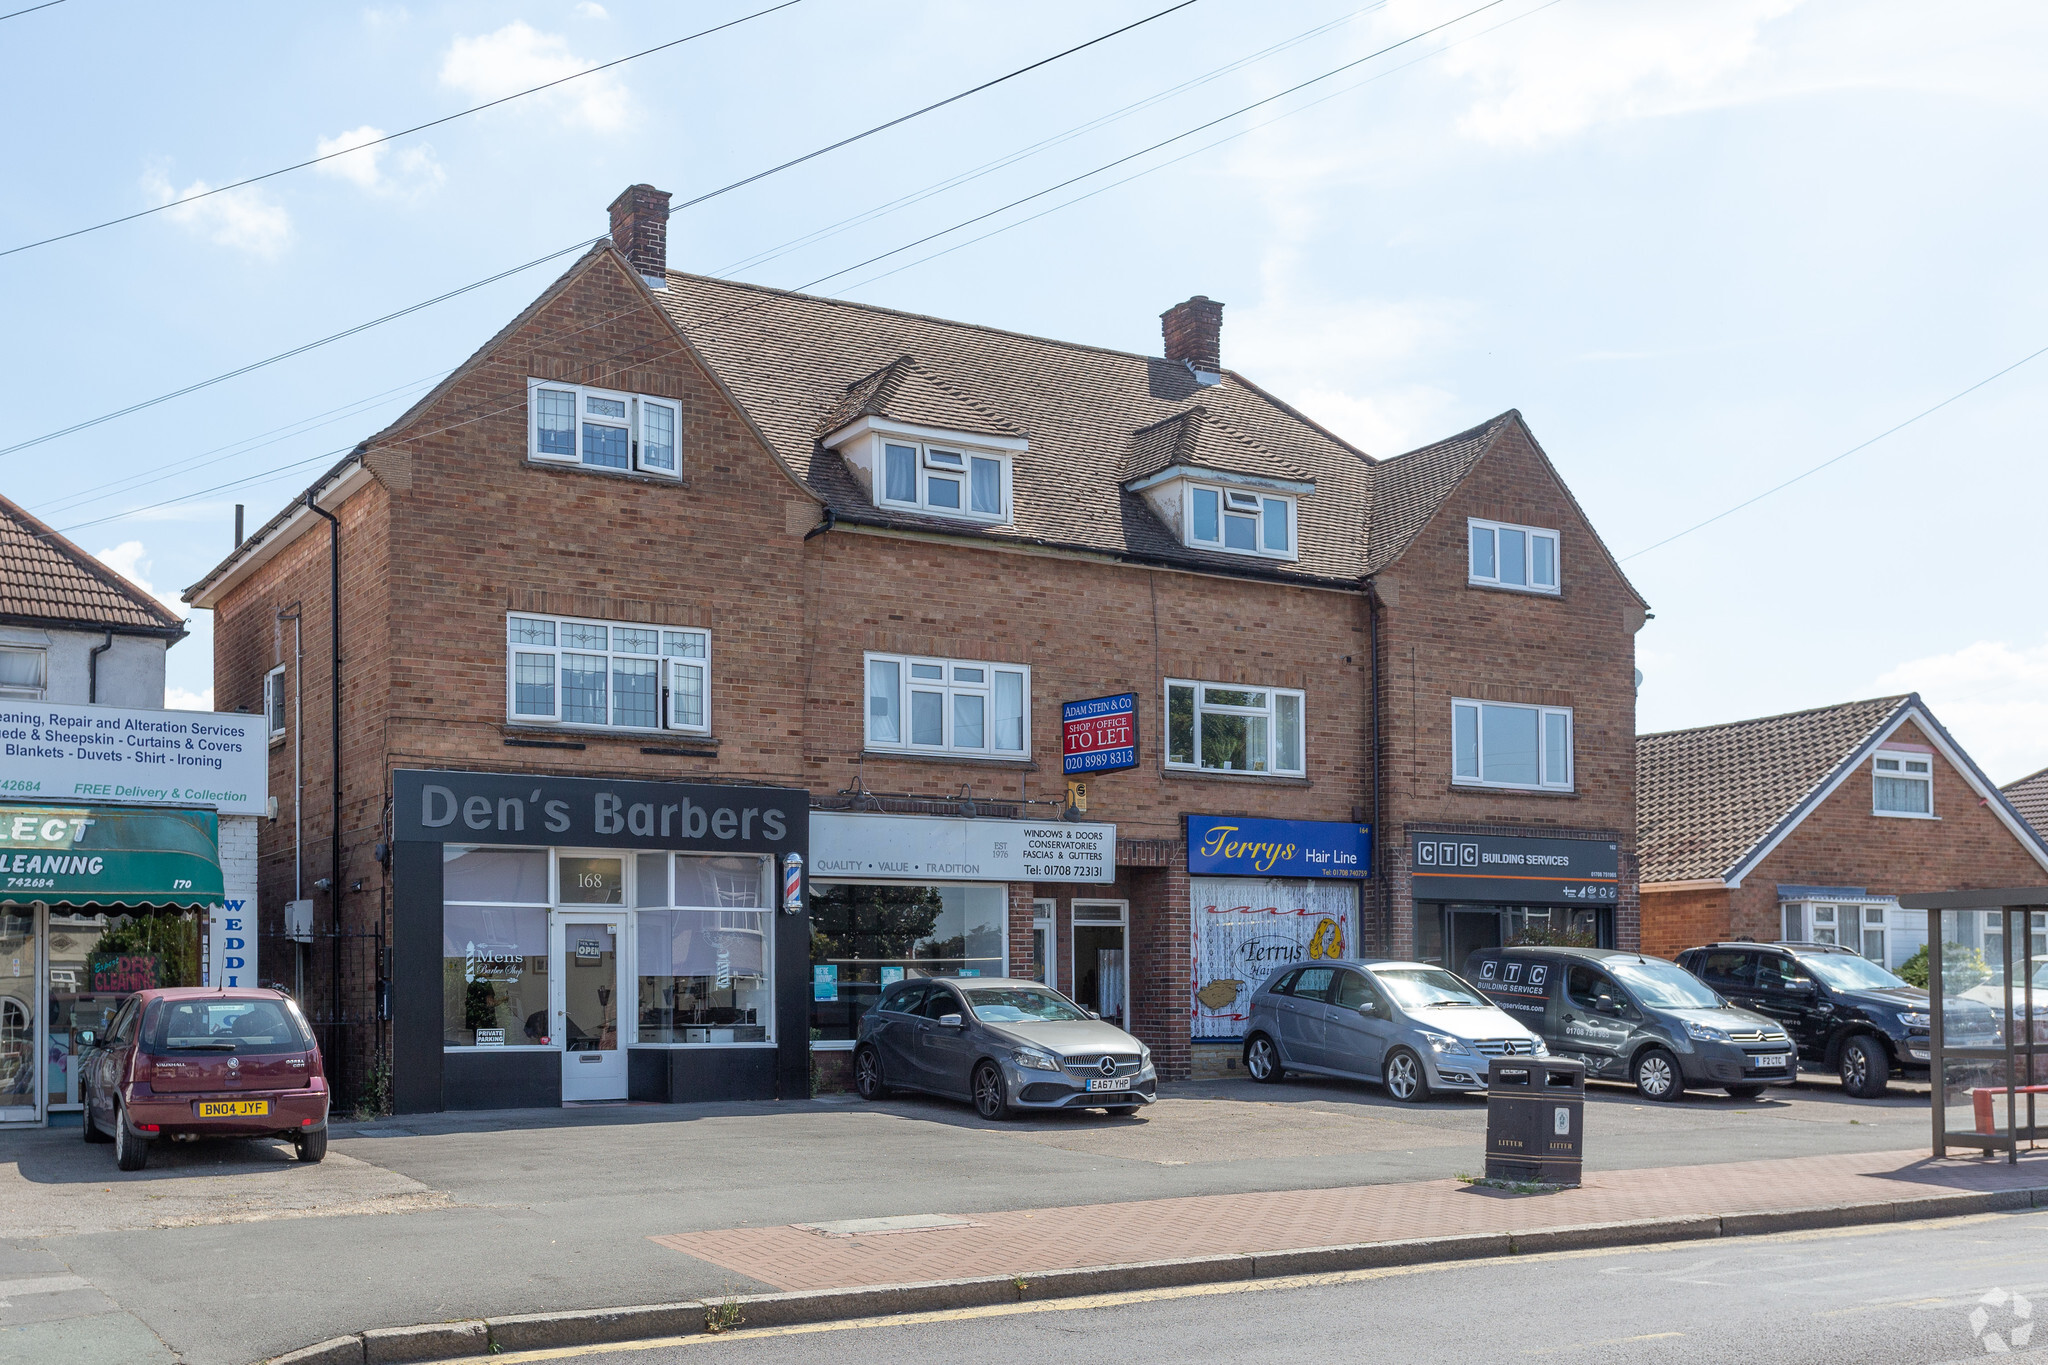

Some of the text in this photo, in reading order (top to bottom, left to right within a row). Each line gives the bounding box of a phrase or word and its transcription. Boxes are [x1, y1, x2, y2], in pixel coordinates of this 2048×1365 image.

[1065, 705, 1087, 717] ADAM
[1111, 700, 1118, 710] &
[49, 713, 93, 729] Repair
[96, 718, 121, 730] and
[124, 718, 187, 734] Alteration
[191, 722, 245, 738] Services
[1069, 722, 1091, 733] SHOP
[1097, 717, 1127, 729] OFFICE
[30, 728, 41, 741] &
[45, 729, 114, 746] Sheepskin
[126, 734, 181, 750] Curtains
[185, 737, 194, 750] &
[198, 738, 242, 753] Covers
[1068, 726, 1130, 750] TO LET
[6, 743, 64, 759] Blankets
[77, 747, 123, 762] Duvets
[135, 750, 166, 764] Shirt
[177, 753, 222, 770] Ironing
[1066, 750, 1133, 770] 020 8989 8313
[74, 783, 112, 796] FREE
[115, 785, 168, 801] Delivery
[171, 788, 181, 799] &
[184, 788, 248, 802] Collection
[594, 791, 788, 842] Barbers
[1023, 829, 1103, 841] WINDOWS & DOORS
[994, 842, 1008, 851] EST
[1028, 840, 1097, 851] CONSERVATORIES
[1201, 825, 1357, 872] Terrys Hair Line
[993, 850, 1009, 859] 1976
[1022, 850, 1103, 861] FASCIAS & GUTTERS
[1481, 853, 1525, 865] BUILDING
[1526, 854, 1569, 866] SERVICES
[817, 860, 981, 875] QUALITY VALUE TRADITION
[1024, 864, 1102, 877] Tel: 01708 723131
[1333, 869, 1348, 877] 01708
[8, 878, 54, 888] 742684
[173, 879, 192, 889] 170
[577, 872, 603, 889] 168
[475, 949, 524, 963] Mens
[578, 946, 600, 956] OPEN
[1241, 940, 1303, 963] Terrys
[119, 955, 156, 973] DRY
[476, 963, 523, 978] Barber Shop
[94, 971, 157, 992] CLEANING
[1477, 981, 1544, 995] BUILDING SERVICES
[1565, 1026, 1585, 1036] 01708
[1091, 1078, 1129, 1090] EA67 YHP
[205, 1102, 262, 1116] BN04 JYF
[1498, 1139, 1523, 1148] LITTER
[1550, 1142, 1573, 1150] LITTER
